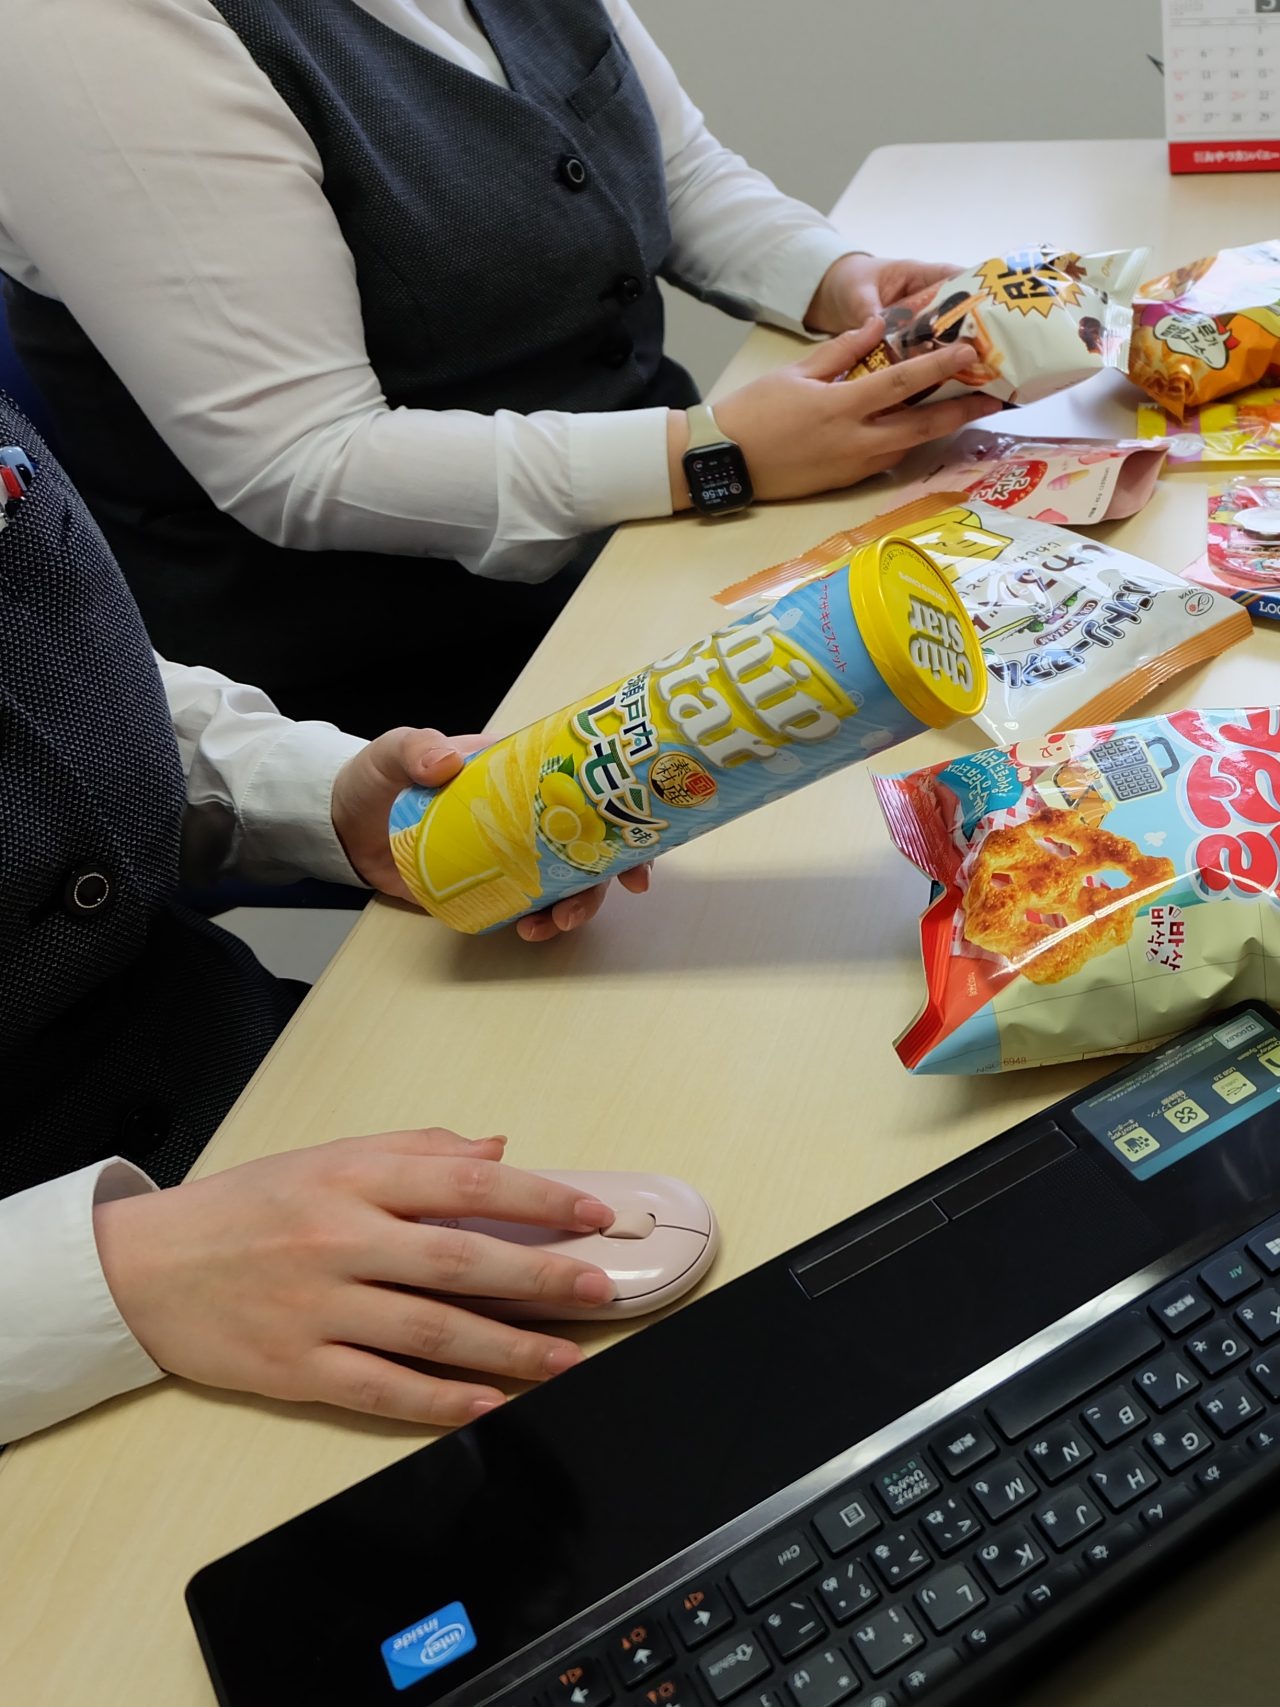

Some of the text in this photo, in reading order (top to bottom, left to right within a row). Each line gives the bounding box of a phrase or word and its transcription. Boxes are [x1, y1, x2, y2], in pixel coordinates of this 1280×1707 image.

[702, 487, 728, 500] 14:56
[910, 598, 965, 654] Star
[715, 609, 842, 743] hip
[909, 643, 974, 692] Chip
[1148, 907, 1167, 955] 바삭
[1167, 920, 1186, 972] 바삭
[1223, 1066, 1236, 1077] USB
[1229, 1266, 1243, 1279] Alt
[1222, 1340, 1237, 1356] C
[1175, 1373, 1189, 1389] V
[1119, 1407, 1135, 1423] B
[1238, 1397, 1251, 1414] F
[1182, 1433, 1199, 1450] G
[1063, 1442, 1081, 1461] N
[1128, 1468, 1145, 1487] H
[1005, 1478, 1025, 1499] M
[1076, 1506, 1089, 1524] J
[777, 1544, 800, 1566] Ctrl
[1015, 1544, 1034, 1566] K
[956, 1584, 974, 1602] L
[392, 1617, 439, 1652] inside
[424, 1629, 463, 1664] intel
